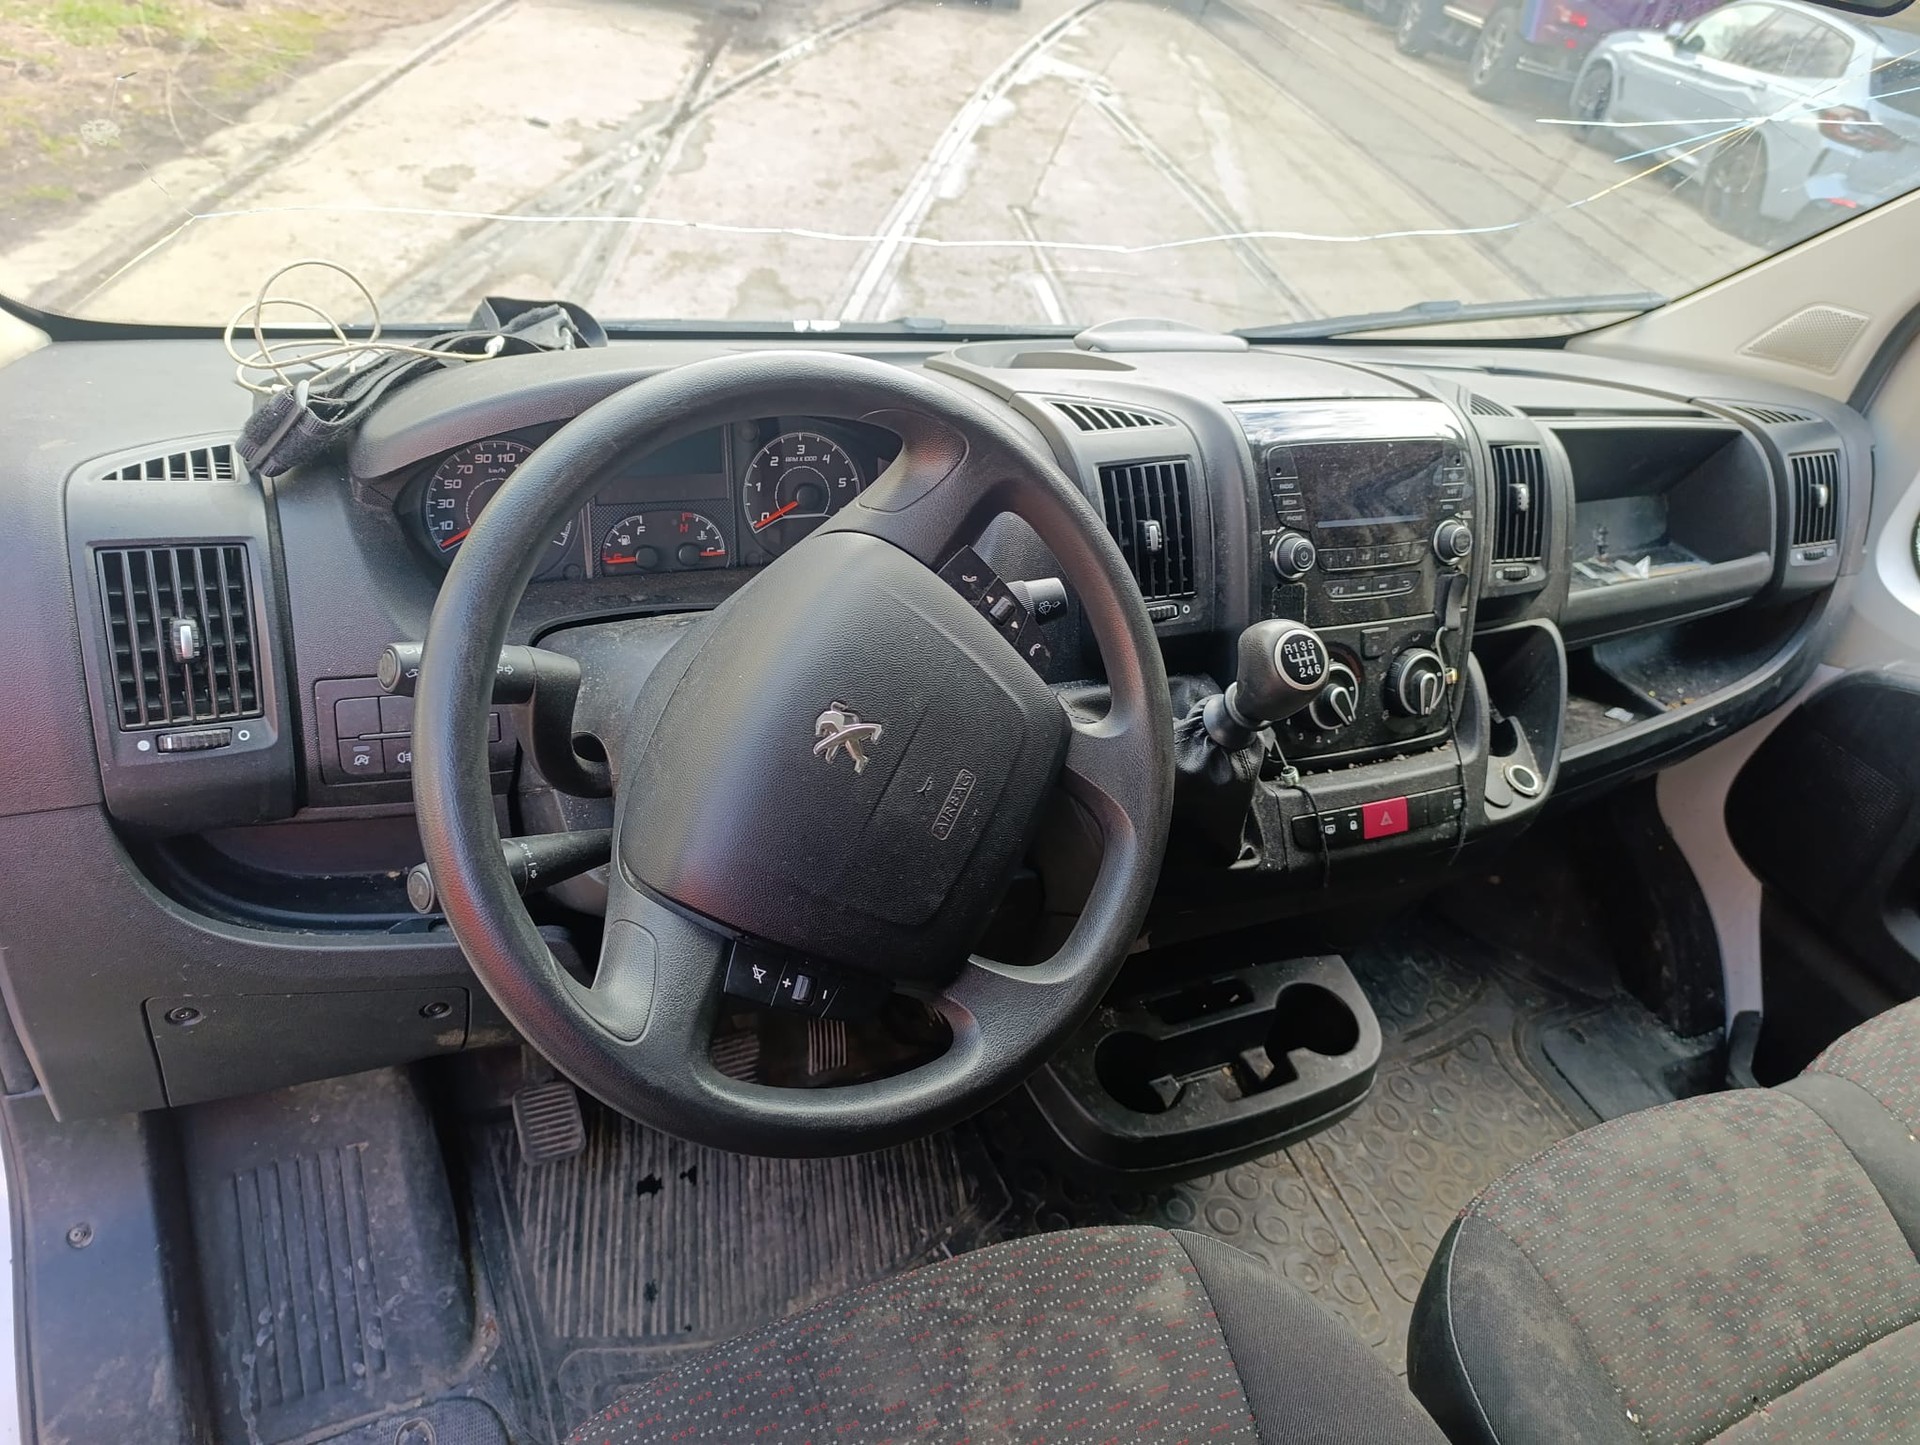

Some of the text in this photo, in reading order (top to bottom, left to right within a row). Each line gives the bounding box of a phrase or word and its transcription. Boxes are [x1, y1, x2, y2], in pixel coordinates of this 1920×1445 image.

[797, 444, 805, 455] 3
[474, 453, 492, 464] 90
[497, 453, 516, 463] 110
[770, 456, 779, 467] 2
[822, 454, 831, 464] 4
[456, 464, 474, 474] 70
[443, 479, 462, 489] 50
[755, 481, 761, 492] 1
[838, 477, 847, 488] 5
[437, 498, 455, 509] 30
[439, 520, 454, 530] 10
[636, 525, 646, 535] F
[679, 523, 689, 533] H
[935, 772, 972, 835] AIRBAG
